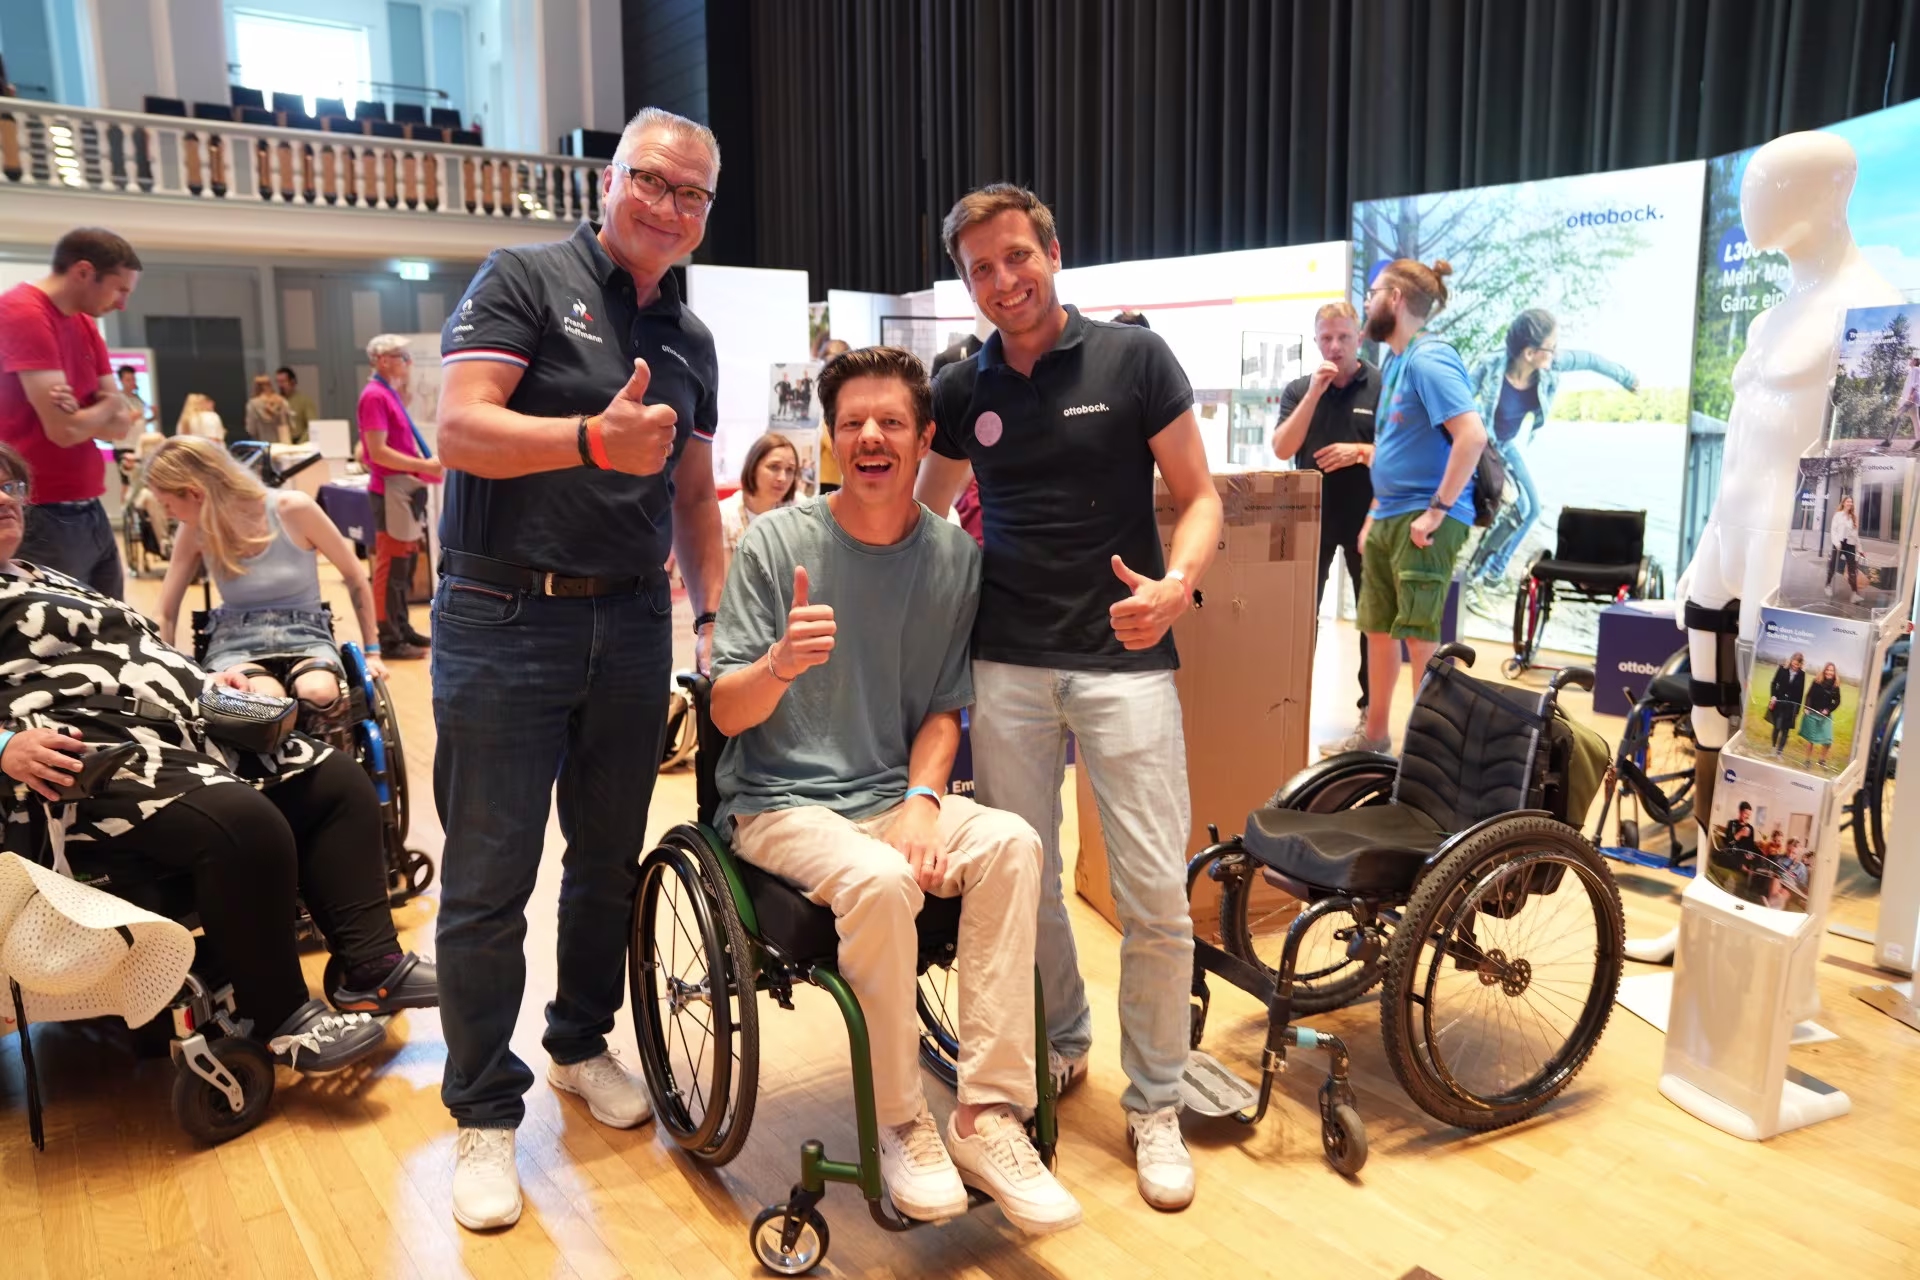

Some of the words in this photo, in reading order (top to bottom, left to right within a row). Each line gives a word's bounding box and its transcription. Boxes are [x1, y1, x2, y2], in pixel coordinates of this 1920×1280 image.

[1566, 204, 1664, 228] ottobock.
[1722, 268, 1760, 288] Mehr
[1721, 294, 1758, 313] Ganz
[563, 316, 587, 330] Frank
[564, 324, 603, 344] Hoffmann
[1063, 402, 1110, 417] ottobock.
